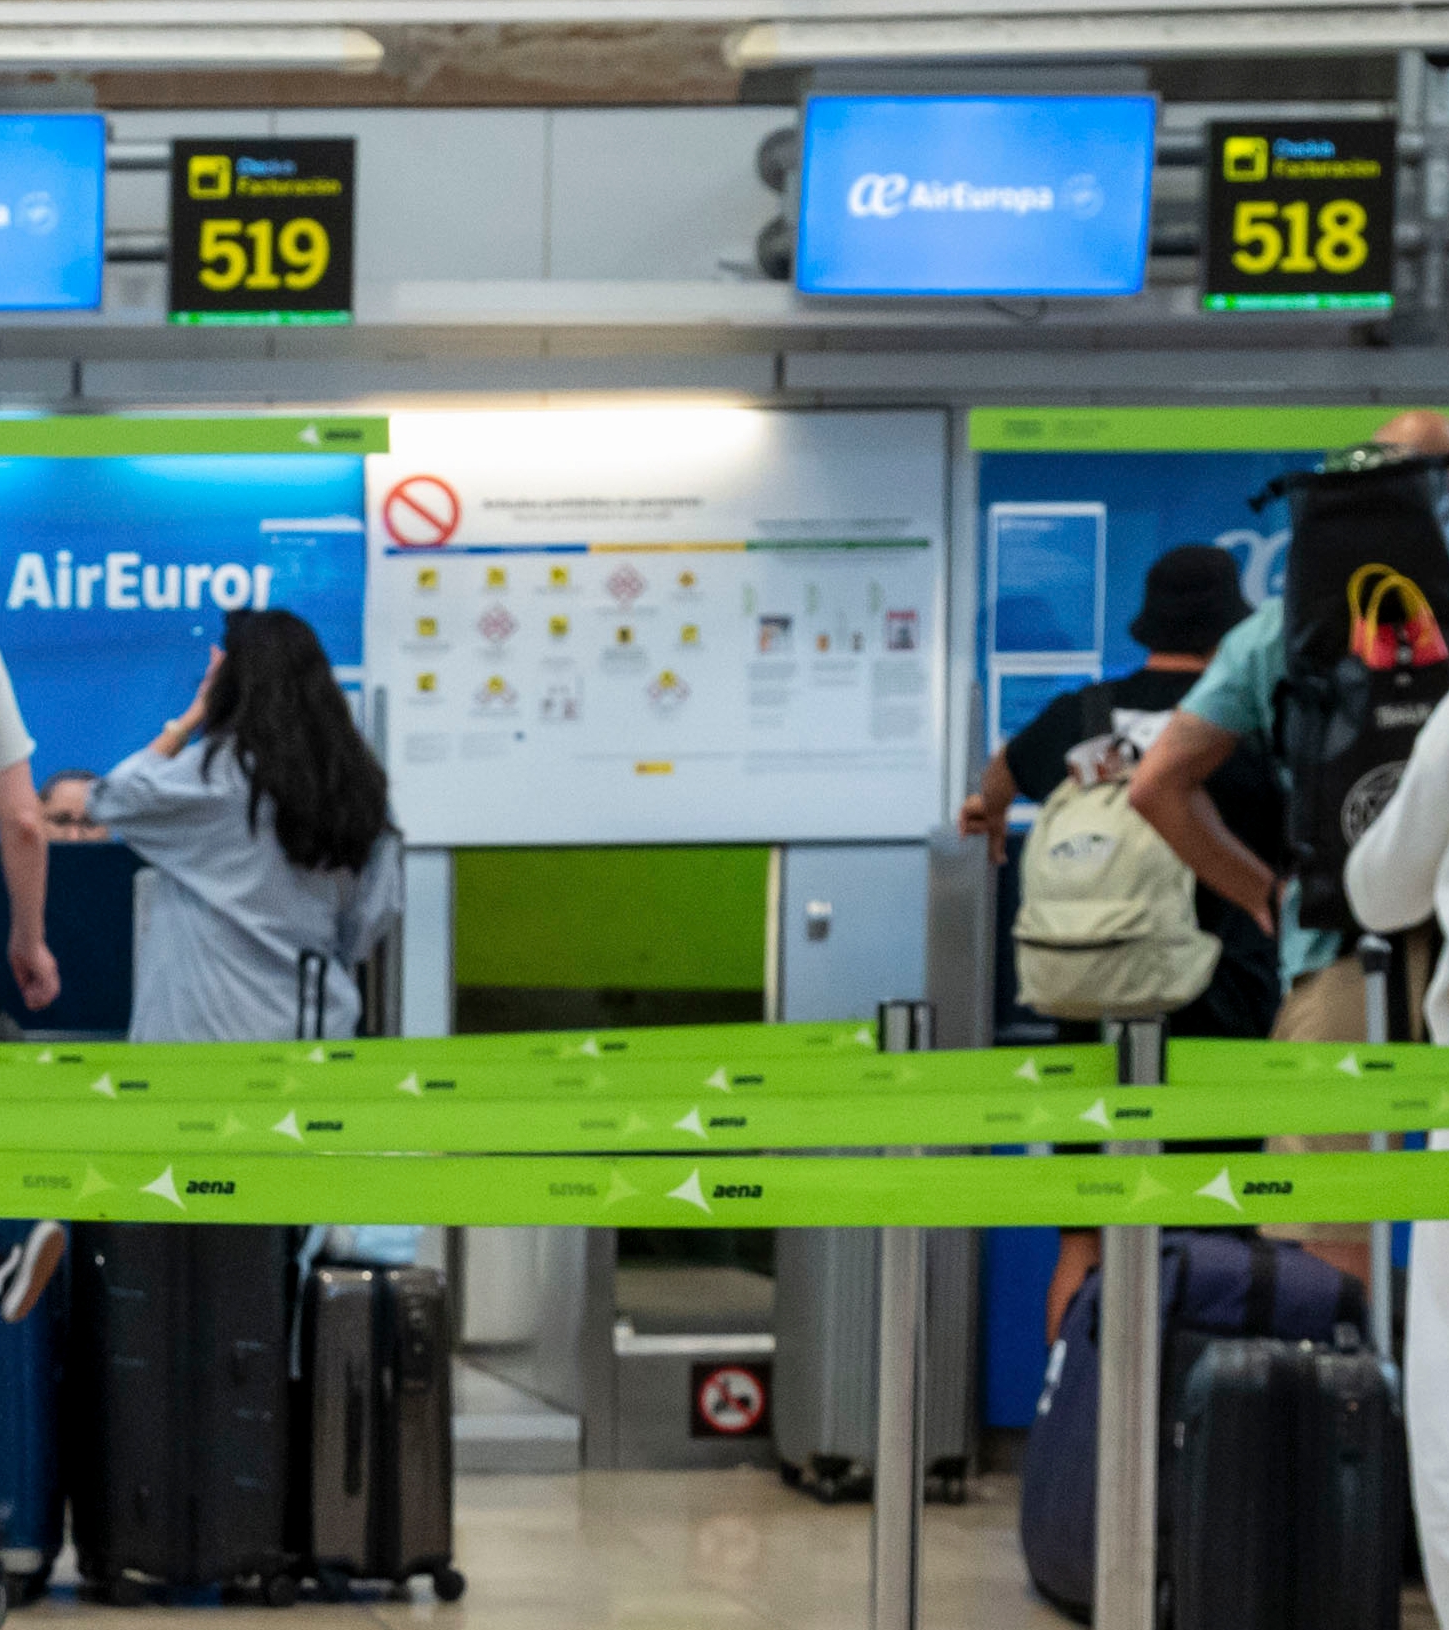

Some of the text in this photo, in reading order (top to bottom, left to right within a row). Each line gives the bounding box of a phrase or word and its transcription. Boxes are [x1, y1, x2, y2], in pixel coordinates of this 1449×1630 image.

[198, 217, 330, 291] 519
[1231, 199, 1368, 274] 518
[8, 549, 273, 612] AirEuro
[186, 1180, 236, 1195] aena
[712, 1184, 763, 1199] aena
[1243, 1181, 1294, 1196] aena
